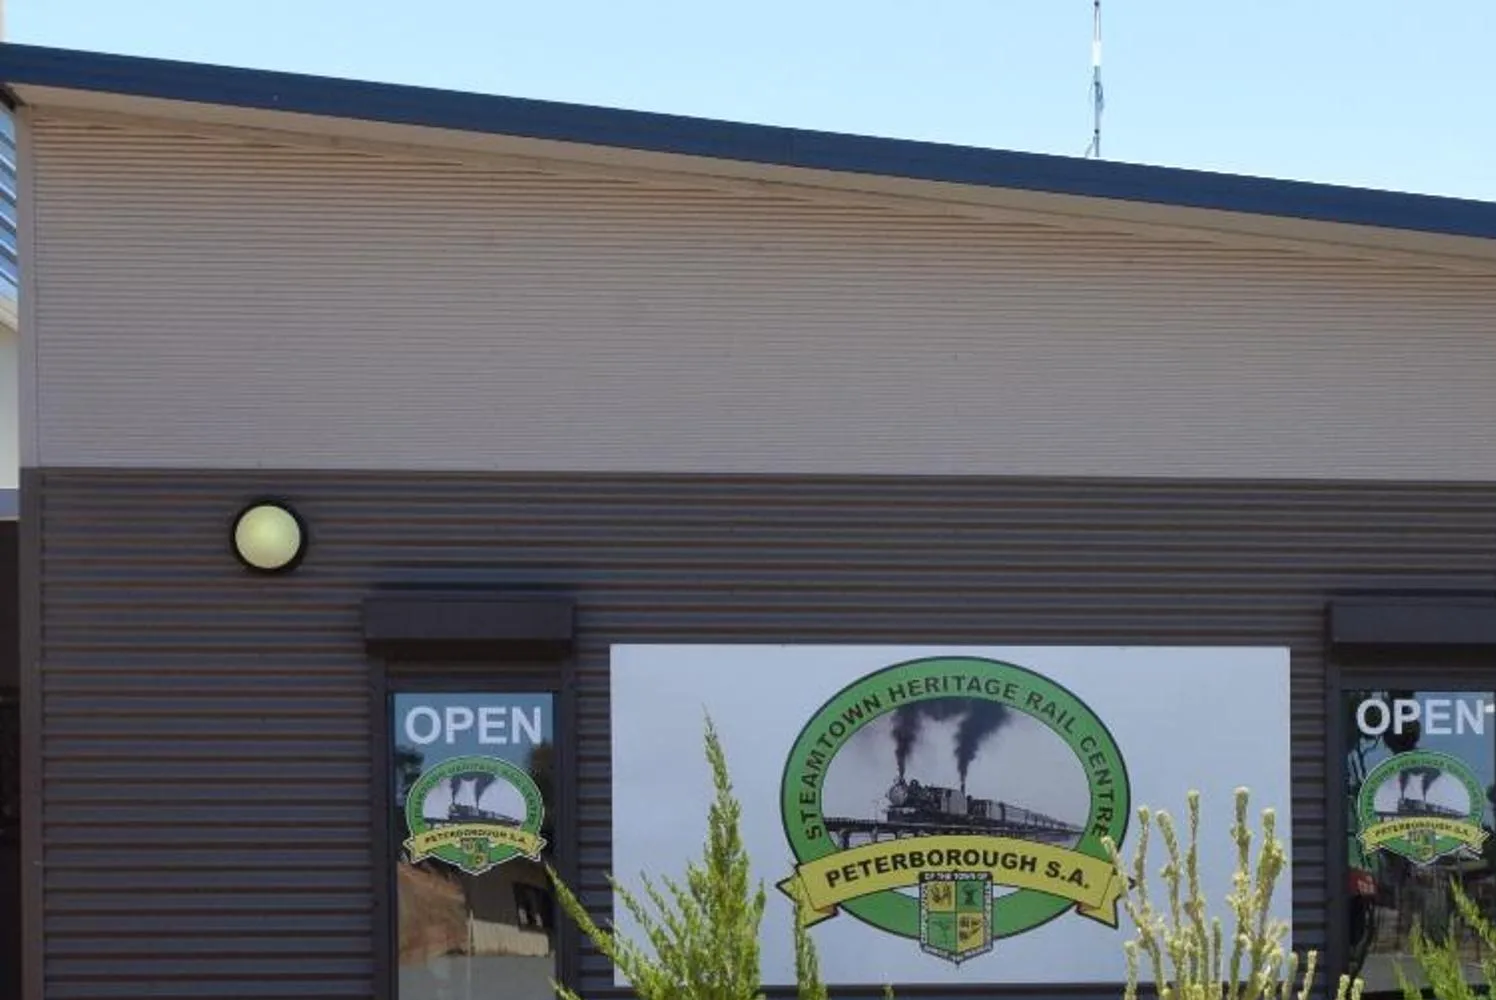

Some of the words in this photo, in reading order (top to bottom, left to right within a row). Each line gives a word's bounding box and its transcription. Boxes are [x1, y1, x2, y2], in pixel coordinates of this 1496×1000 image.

[405, 706, 541, 745] OPEN
[1357, 699, 1484, 735] OPEN
[801, 693, 882, 841] STEAMTOWN
[888, 675, 1019, 703] HERITAGE
[1025, 690, 1076, 735] RAIL
[825, 849, 1037, 888] PETERBOROUGH
[1044, 860, 1090, 890] S.A.
